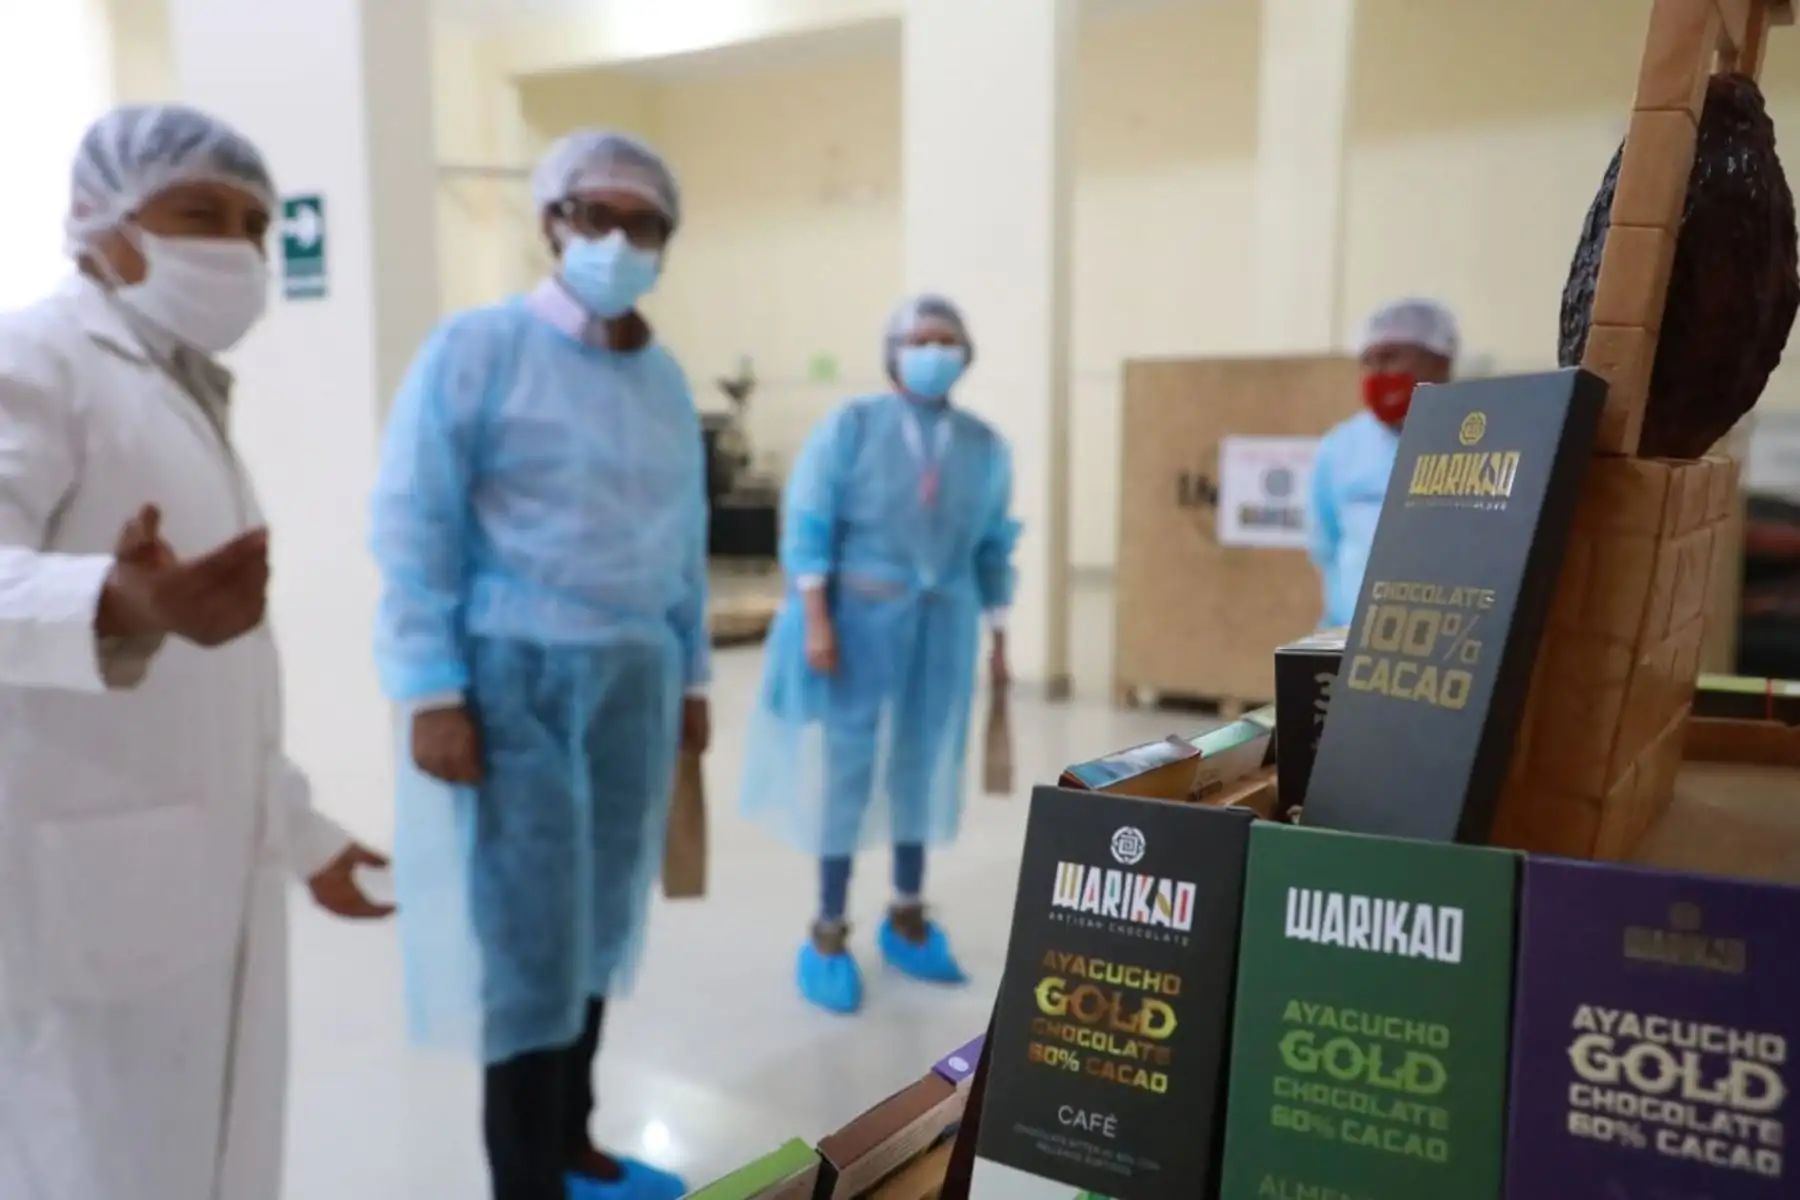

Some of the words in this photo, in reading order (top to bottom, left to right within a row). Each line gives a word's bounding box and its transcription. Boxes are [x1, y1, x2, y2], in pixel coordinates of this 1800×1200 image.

[1372, 581, 1496, 610] CHOCOLATE
[1360, 603, 1483, 664] 100%
[1348, 654, 1473, 709] CACAO
[1285, 887, 1464, 963] WARIKAO
[1042, 949, 1182, 996] AYACUCHO
[1034, 976, 1178, 1039] GOLD
[1283, 999, 1450, 1049] AYACUCHO
[1571, 1004, 1786, 1063] AYACUCHO
[1032, 1017, 1171, 1065] CHOCOLATE
[1279, 1029, 1447, 1096] GOLD
[1085, 1057, 1168, 1093] CACAO
[1566, 1033, 1787, 1112] GOLD
[1058, 1104, 1119, 1138] CAFÉ
[1273, 1075, 1449, 1130] CHOCOLATE
[1568, 1082, 1783, 1146] CHOCOLATE
[1341, 1119, 1449, 1163] CACAO
[1656, 1129, 1782, 1178] CACAO
